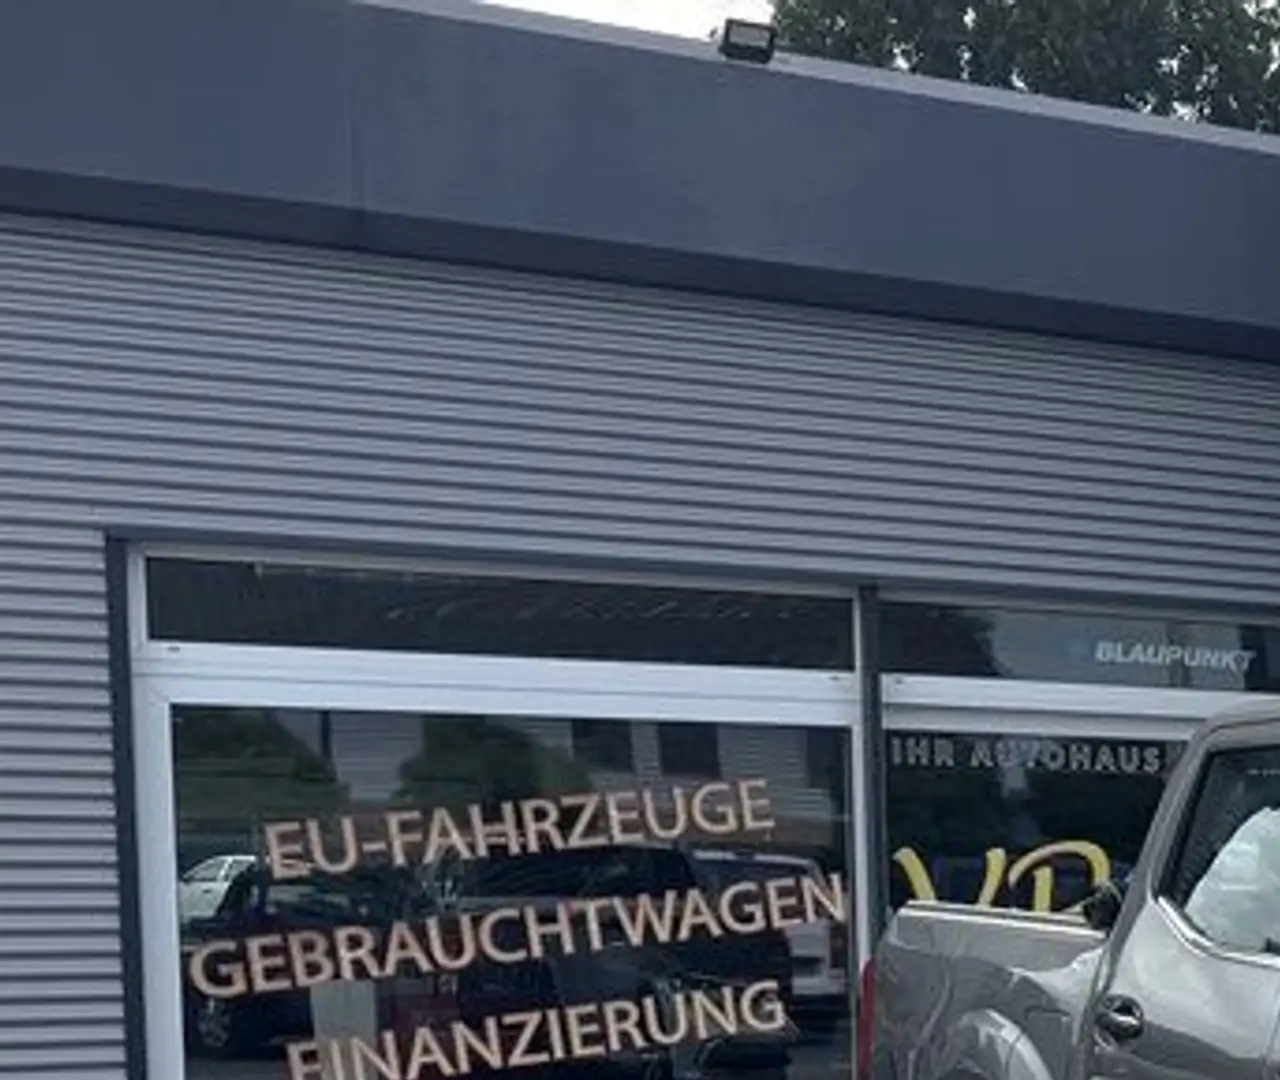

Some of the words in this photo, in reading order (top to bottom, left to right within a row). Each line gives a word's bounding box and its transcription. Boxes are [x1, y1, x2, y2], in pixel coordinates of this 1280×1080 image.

[1094, 641, 1256, 673] BLAUPUNKT
[892, 737, 954, 768] IHR
[971, 738, 1160, 773] AUTOHAUS
[264, 779, 776, 880] EU-FAHRZEUGE
[190, 873, 848, 997] GEBRAUCHTWAGEN
